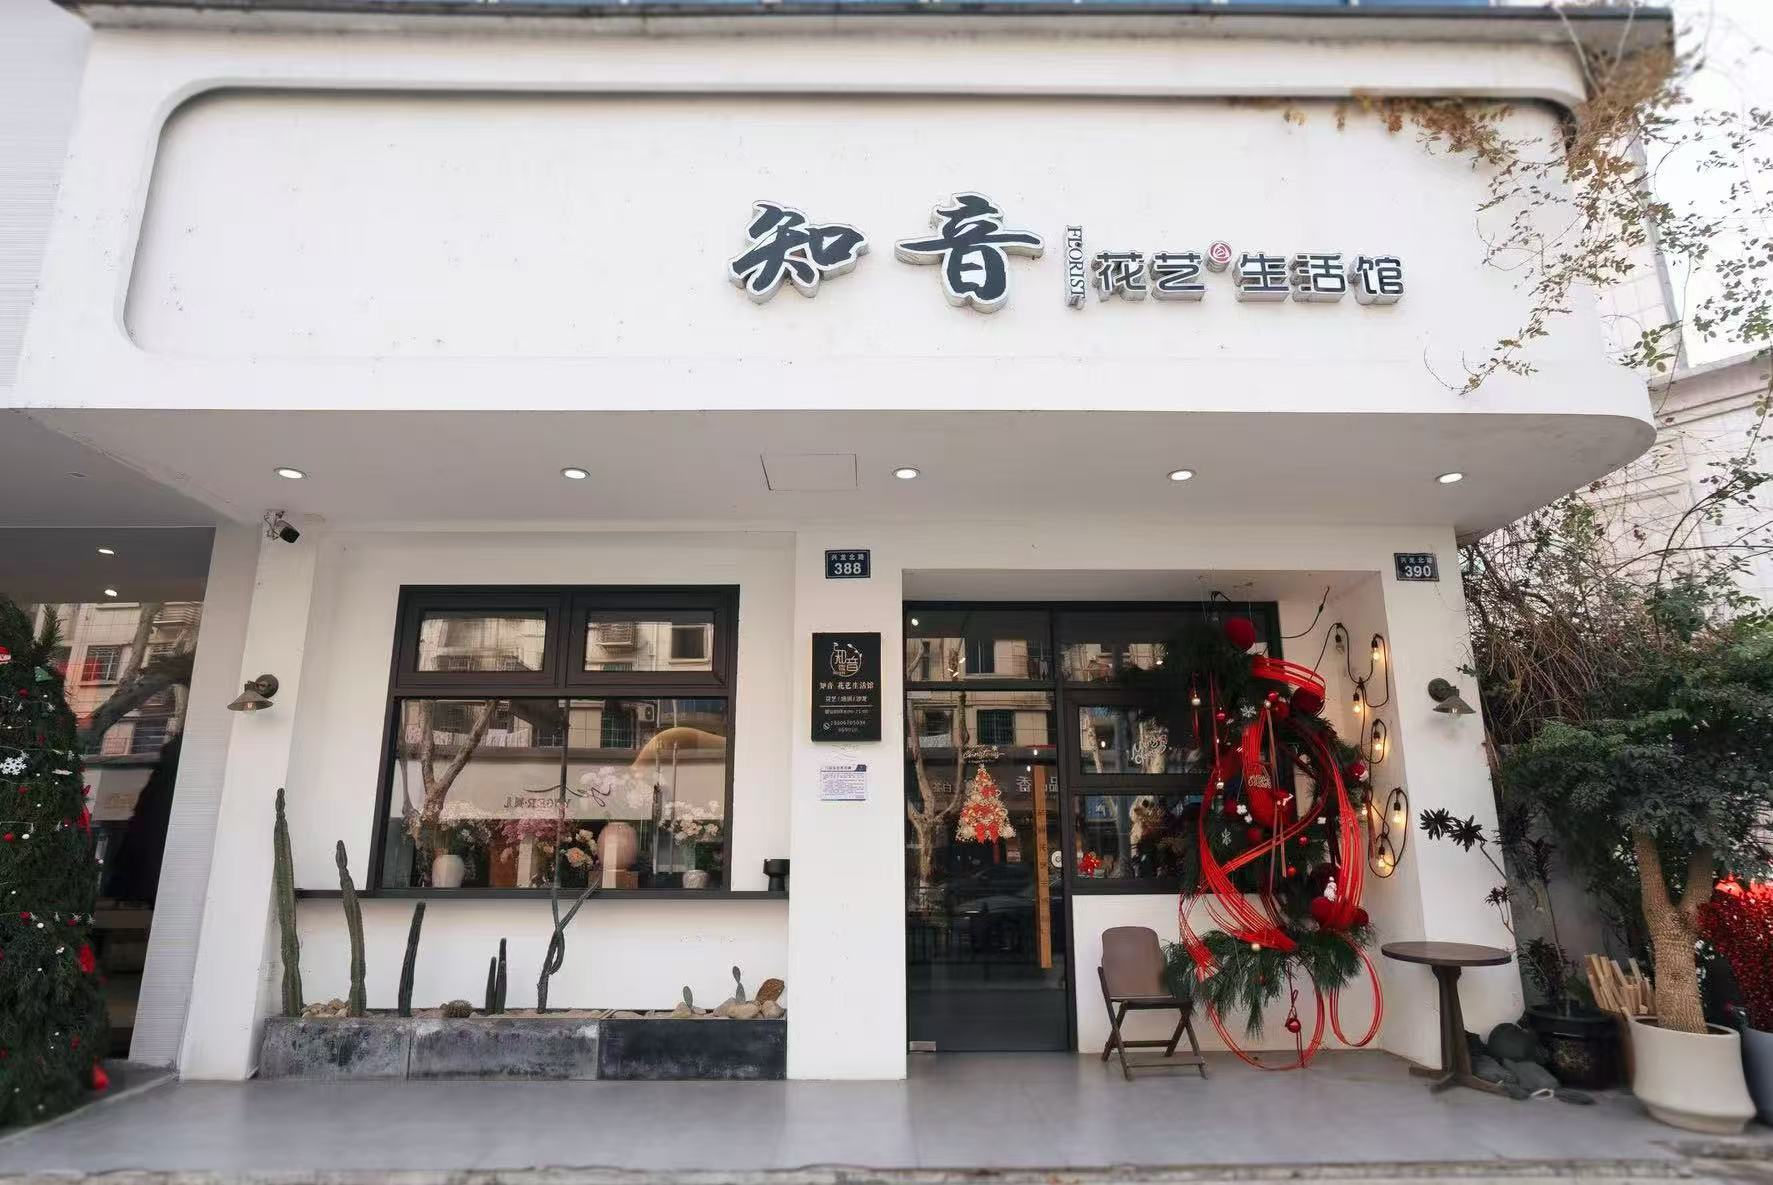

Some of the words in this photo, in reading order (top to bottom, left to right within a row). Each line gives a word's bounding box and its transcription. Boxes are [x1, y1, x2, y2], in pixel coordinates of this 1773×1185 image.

[729, 193, 1043, 303] 知音
[1067, 227, 1086, 299] FLORIST
[834, 562, 862, 575] 388
[1404, 565, 1432, 577] 390
